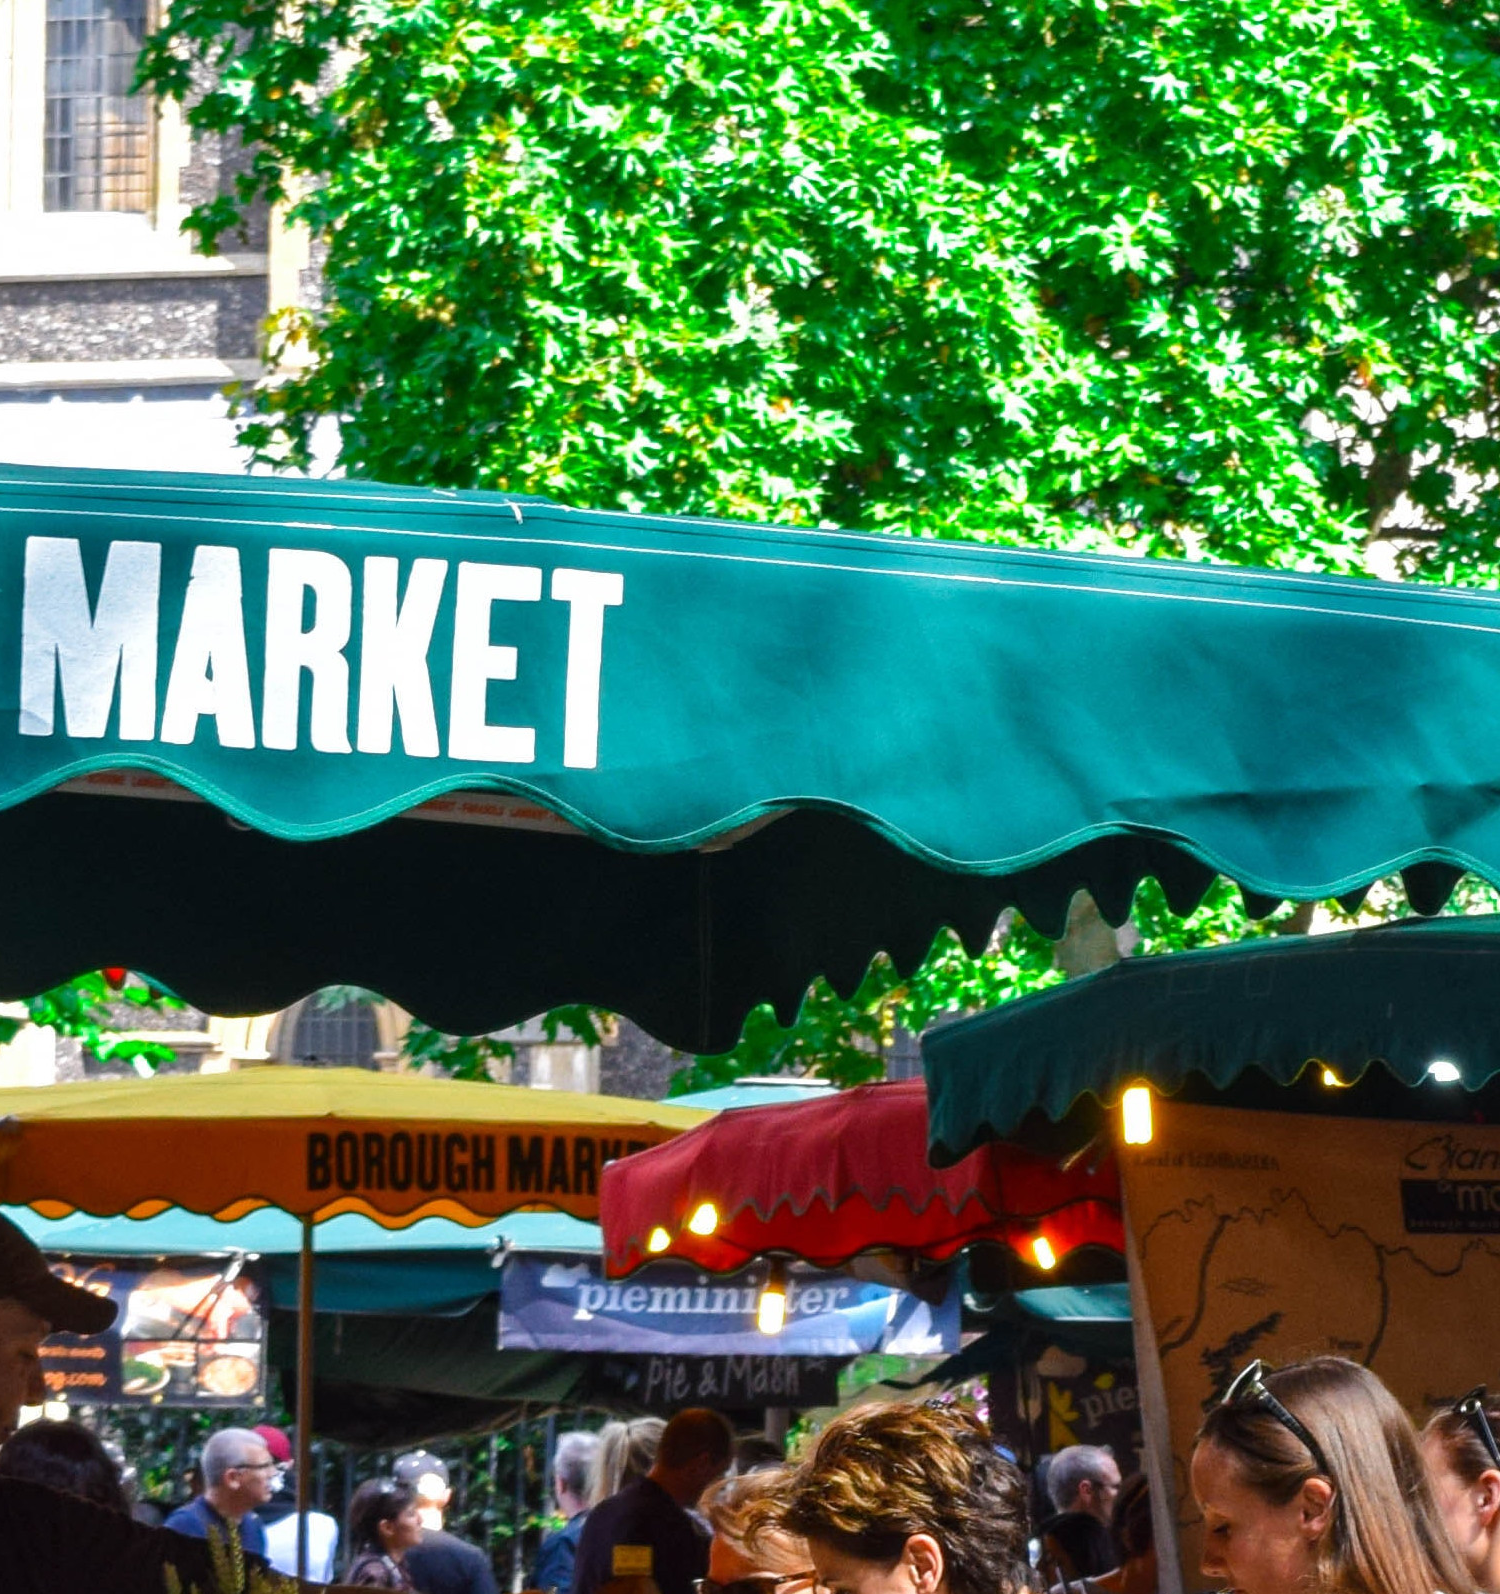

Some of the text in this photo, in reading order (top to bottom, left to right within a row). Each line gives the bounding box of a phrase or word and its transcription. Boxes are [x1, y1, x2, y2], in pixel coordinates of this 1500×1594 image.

[16, 536, 624, 768] MARKET
[307, 1130, 657, 1194] BOROUGH MAR
[575, 1274, 850, 1322] pieminiter
[697, 1362, 718, 1398] &
